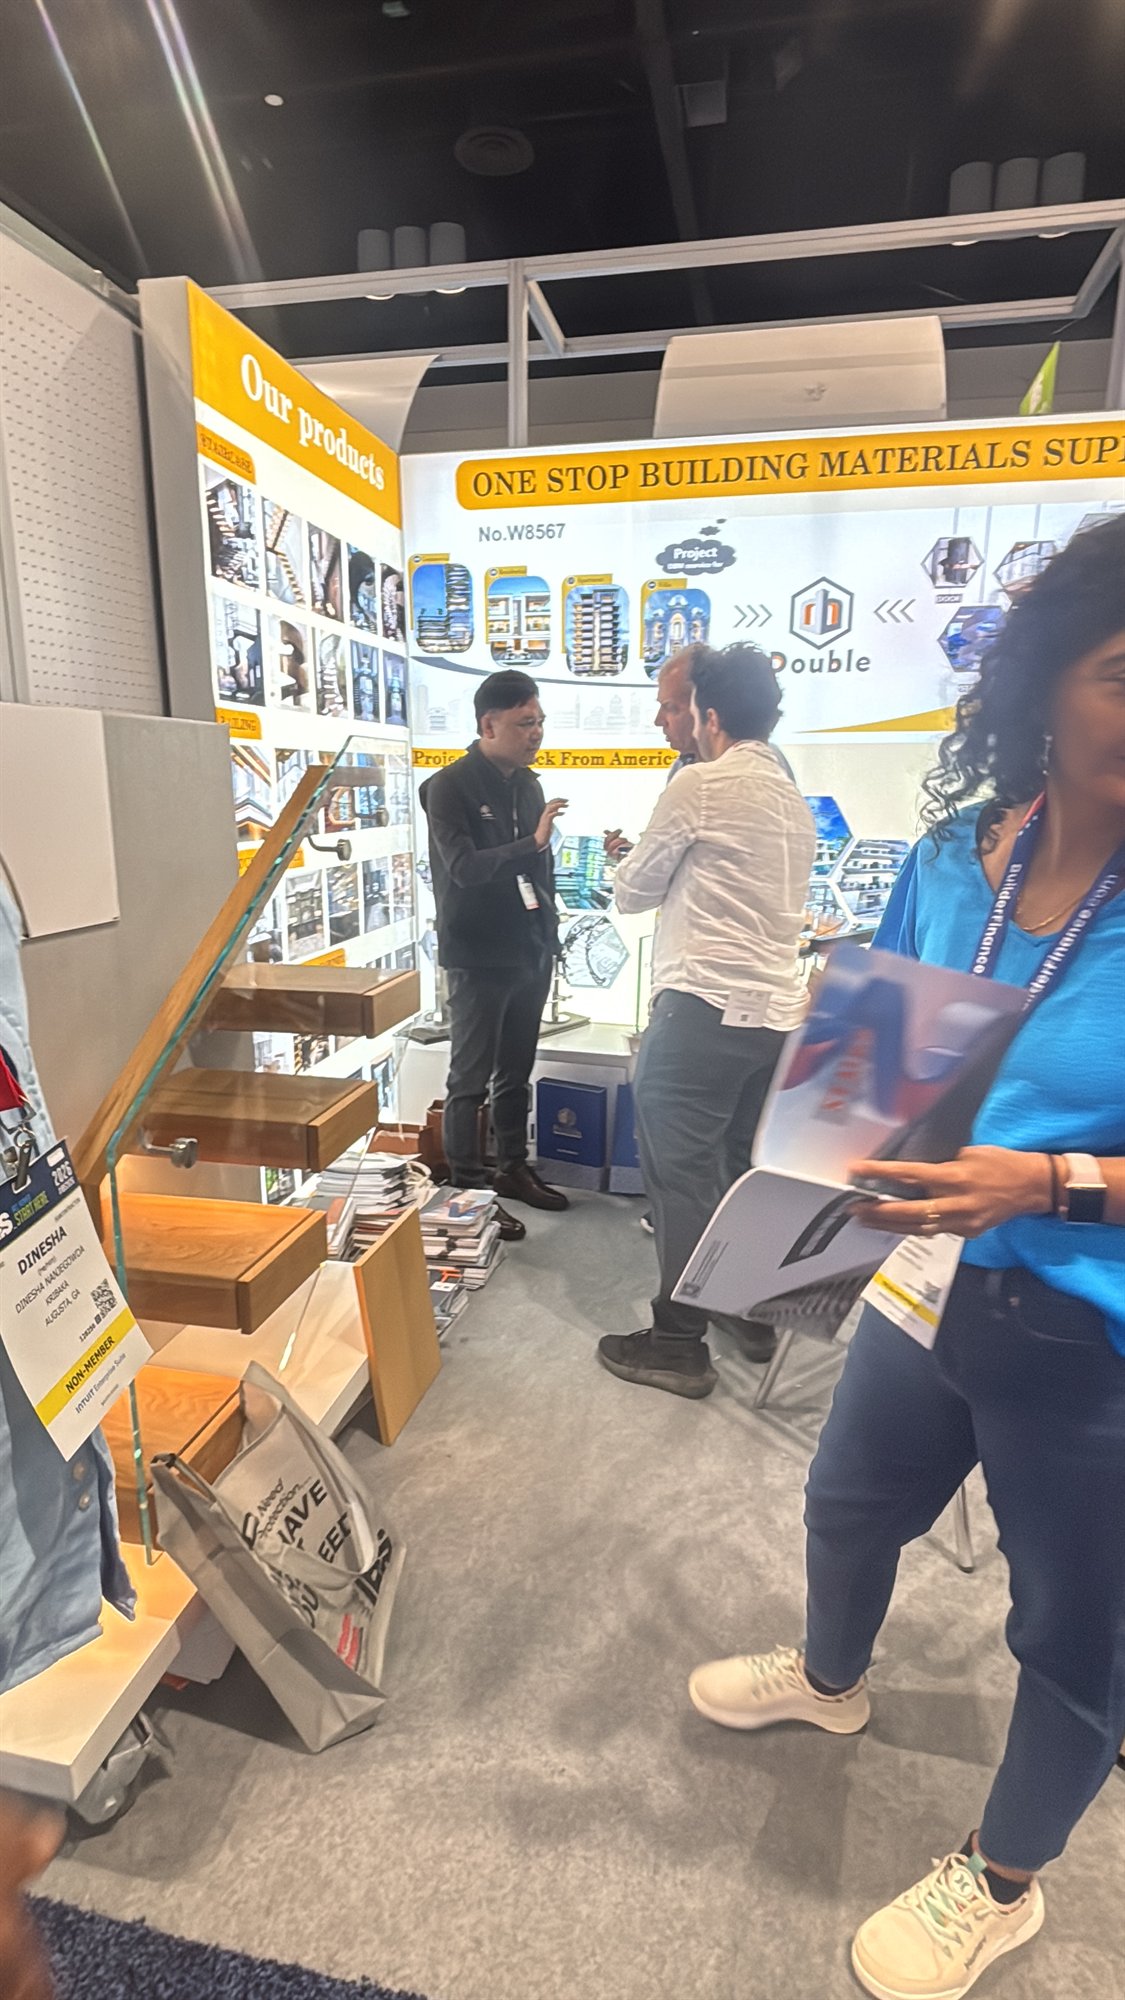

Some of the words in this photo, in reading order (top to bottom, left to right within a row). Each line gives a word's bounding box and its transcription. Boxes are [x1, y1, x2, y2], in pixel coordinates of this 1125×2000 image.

[241, 354, 293, 424] Our
[297, 407, 385, 491] products
[473, 470, 536, 497] ONE
[547, 464, 629, 493] STOP
[640, 452, 808, 488] BUILDING
[819, 440, 1032, 478] MATERIALS
[479, 523, 566, 542] No.W8567
[673, 547, 718, 562] Project
[769, 649, 871, 674] Double
[412, 750, 456, 766] Proje
[560, 751, 605, 766] From
[610, 751, 678, 766] Americ
[51, 1160, 73, 1187] 2026
[17, 1226, 68, 1275] DINESHA
[15, 1282, 45, 1313] DINESHA
[71, 1288, 81, 1300] GA
[65, 1336, 115, 1394] NON-MEMBER
[75, 1388, 96, 1414] INTUIT
[257, 1477, 284, 1518] Need
